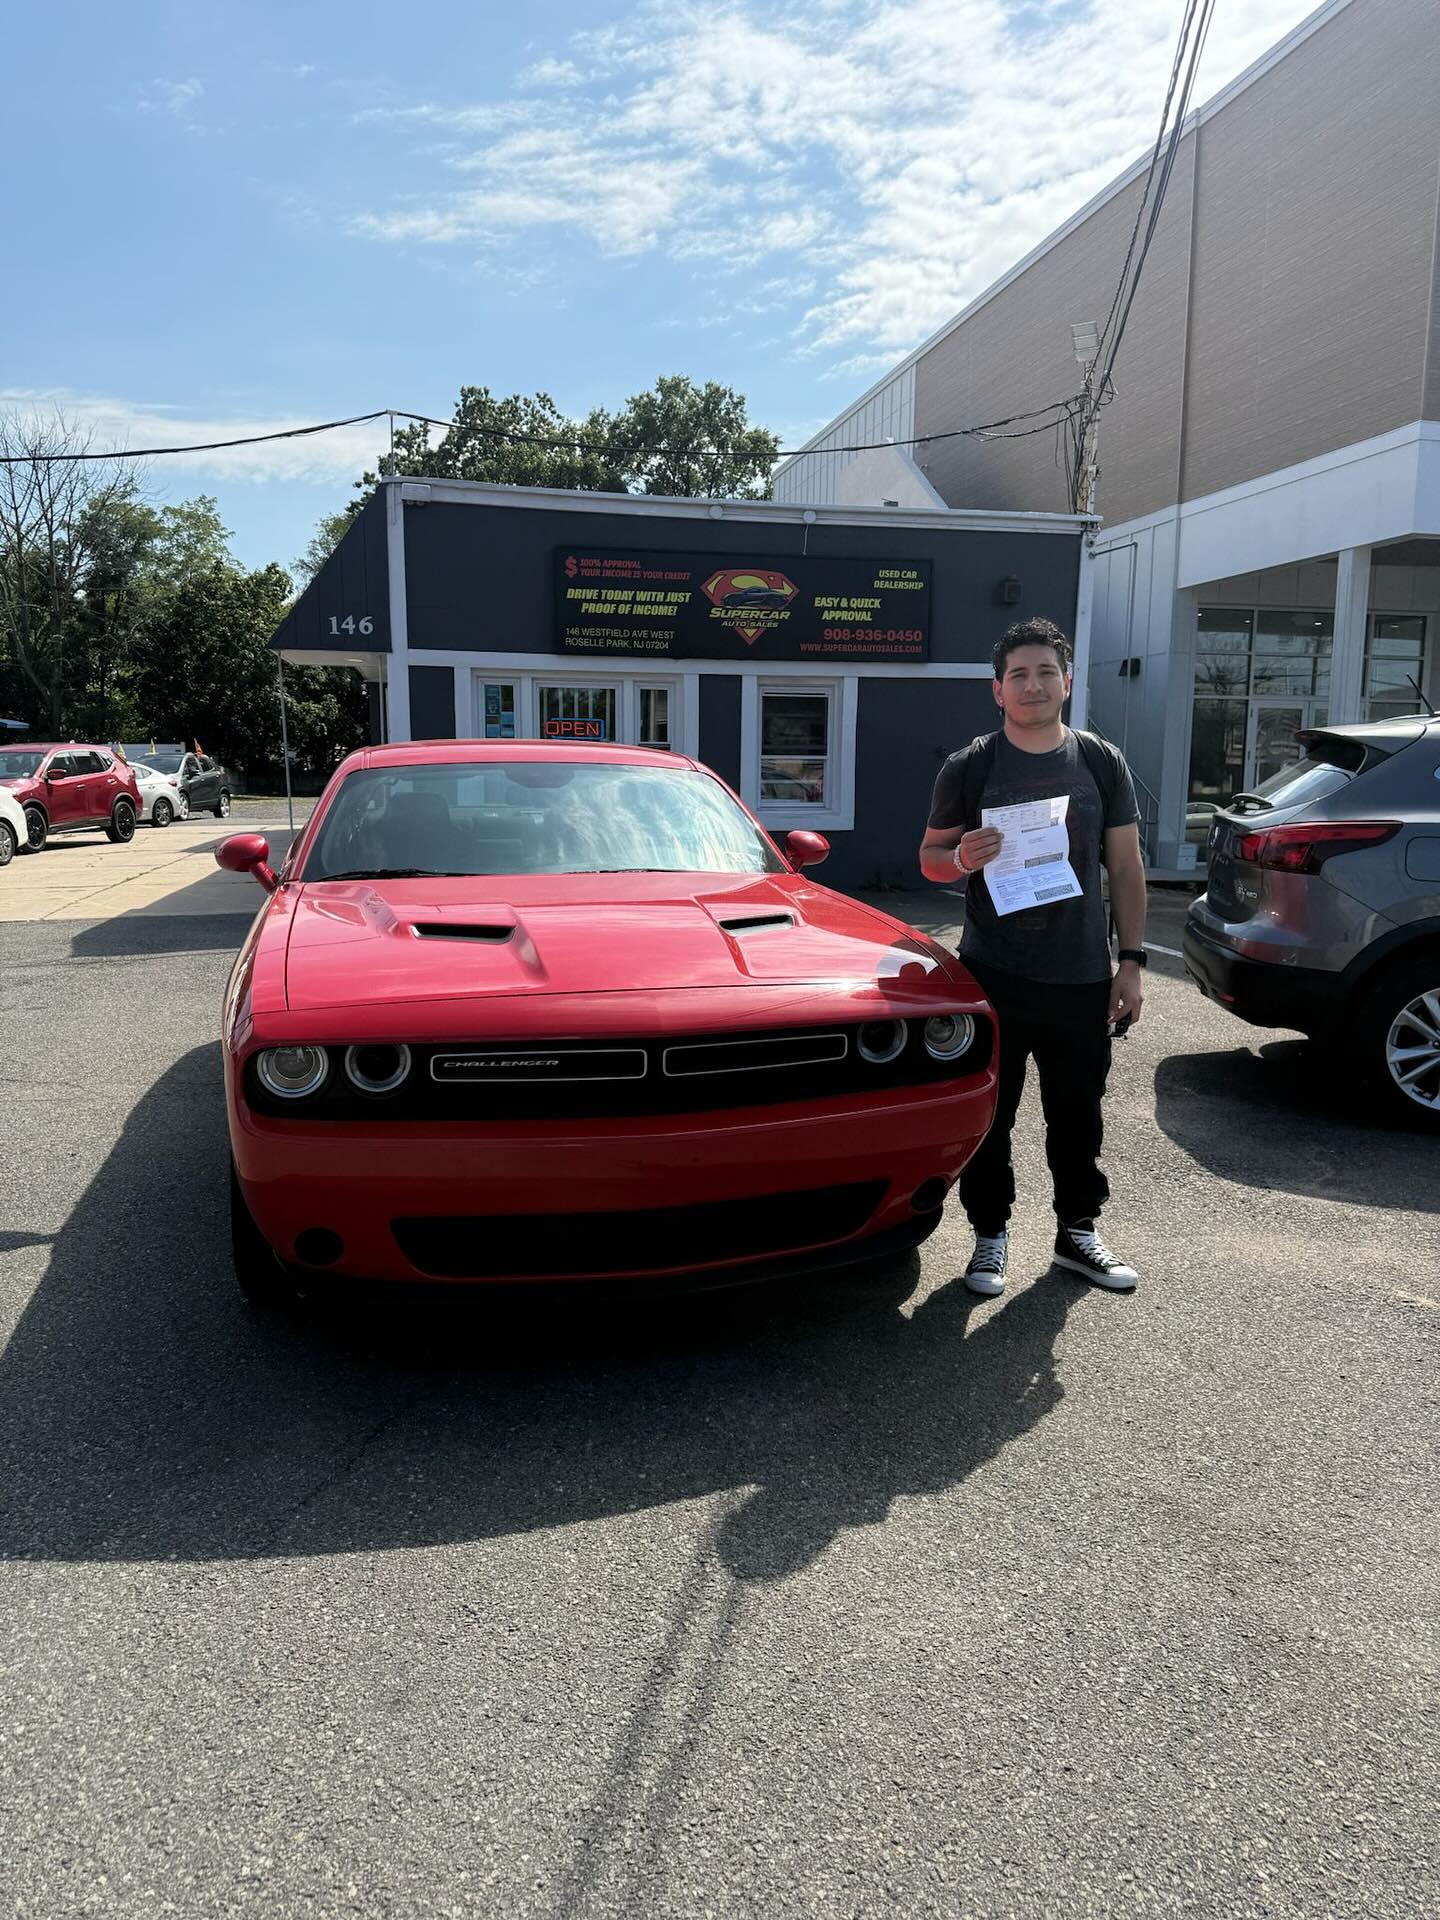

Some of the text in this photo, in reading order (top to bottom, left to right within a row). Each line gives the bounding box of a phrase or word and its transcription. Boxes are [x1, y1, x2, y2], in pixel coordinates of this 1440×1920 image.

[580, 559, 641, 569] 100% APPROVAL
[580, 569, 601, 577] YOUR
[601, 569, 632, 579] INCOME
[643, 570, 664, 579] YOUR
[664, 571, 691, 580] CREDIT
[879, 569, 918, 580] USED CAR
[873, 580, 924, 591] DEALERSHIP
[566, 587, 692, 603] DRIVE TODAY WITH JUST
[580, 601, 678, 616] PROOF OF INCOME!
[814, 596, 882, 610] EASY & QUICK
[709, 607, 792, 620] SUPERCAR
[821, 610, 873, 621] APPROVAL
[328, 614, 374, 635] 146
[721, 619, 780, 629] AUTO SALES
[581, 627, 631, 639] WESTFIELD
[631, 629, 650, 639] AVE
[650, 630, 675, 640] WEST
[823, 628, 923, 641] 908-936-0450
[565, 637, 606, 648] ROSELLE
[633, 640, 646, 649] NJ
[646, 640, 669, 650] 07204
[545, 721, 600, 737] OPEN
